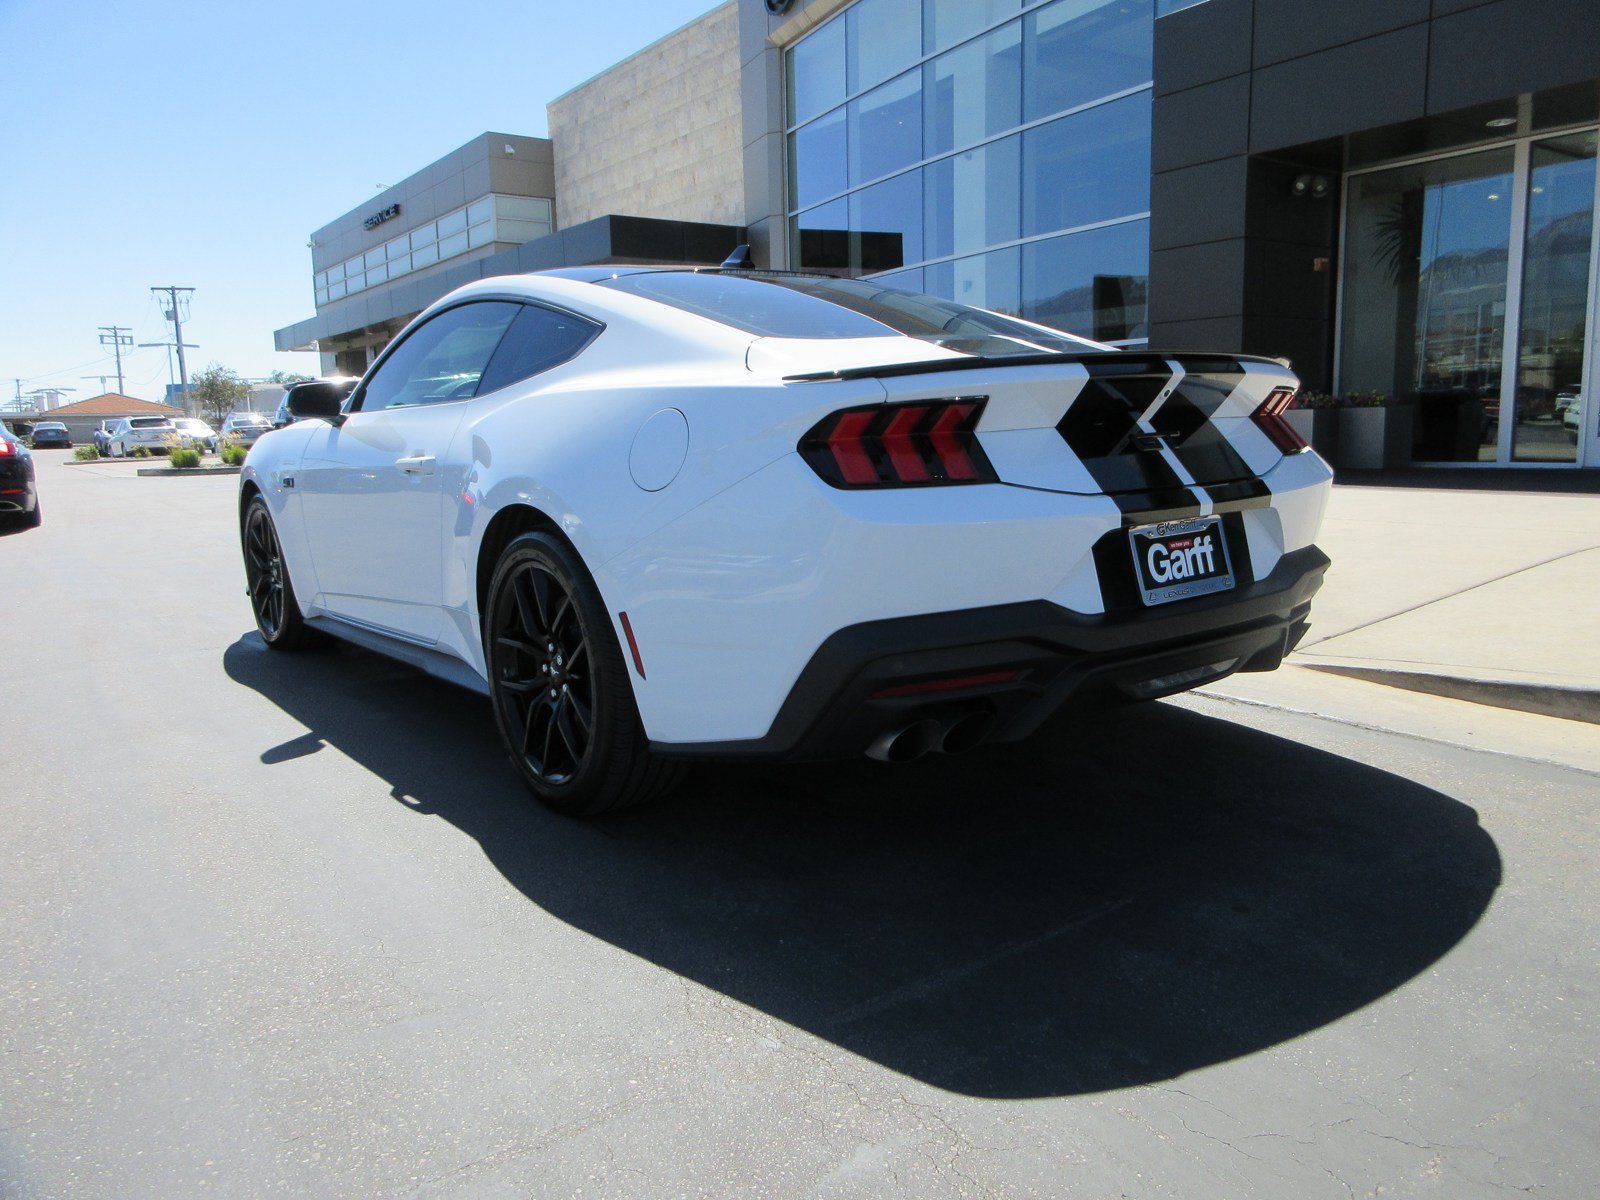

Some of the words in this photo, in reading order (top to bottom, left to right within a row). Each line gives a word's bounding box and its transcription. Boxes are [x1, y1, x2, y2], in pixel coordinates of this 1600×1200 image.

[364, 203, 401, 229] SERVICE
[1164, 521, 1178, 532] Ken
[1178, 519, 1197, 530] Garff
[1147, 535, 1215, 583] Garff
[1163, 586, 1191, 599] LEXUS
